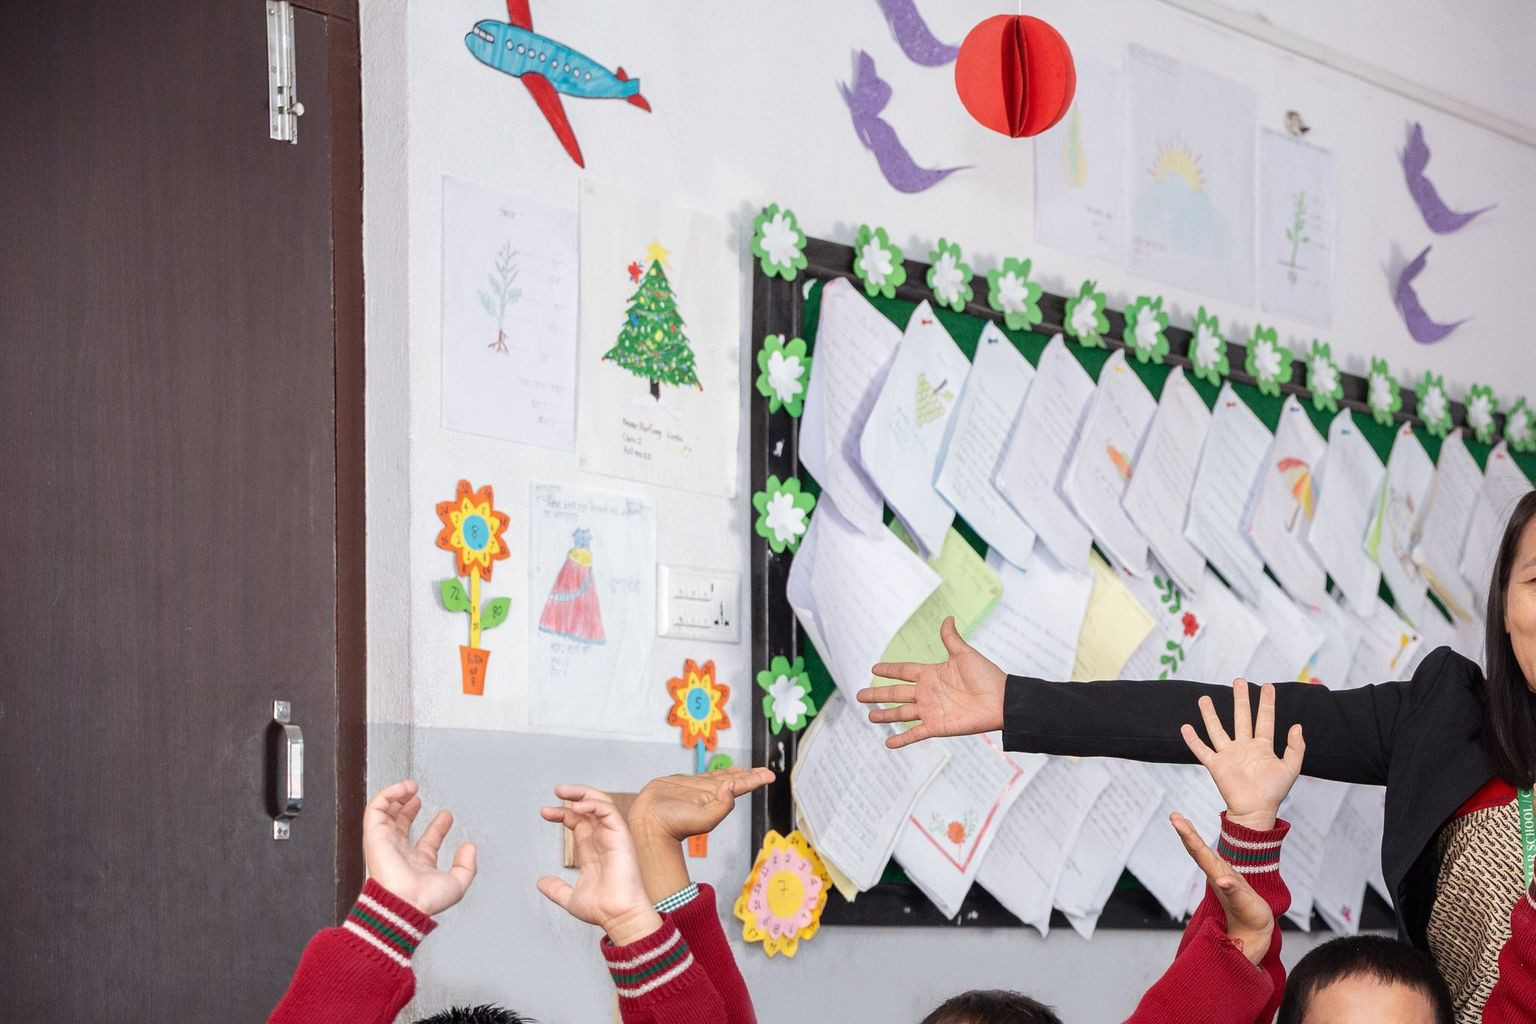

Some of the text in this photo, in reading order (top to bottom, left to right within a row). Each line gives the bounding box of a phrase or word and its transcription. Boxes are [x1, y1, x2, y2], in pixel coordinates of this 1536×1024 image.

[471, 524, 478, 540] 8
[695, 696, 703, 711] 5
[1523, 804, 1536, 852] SCHOOL
